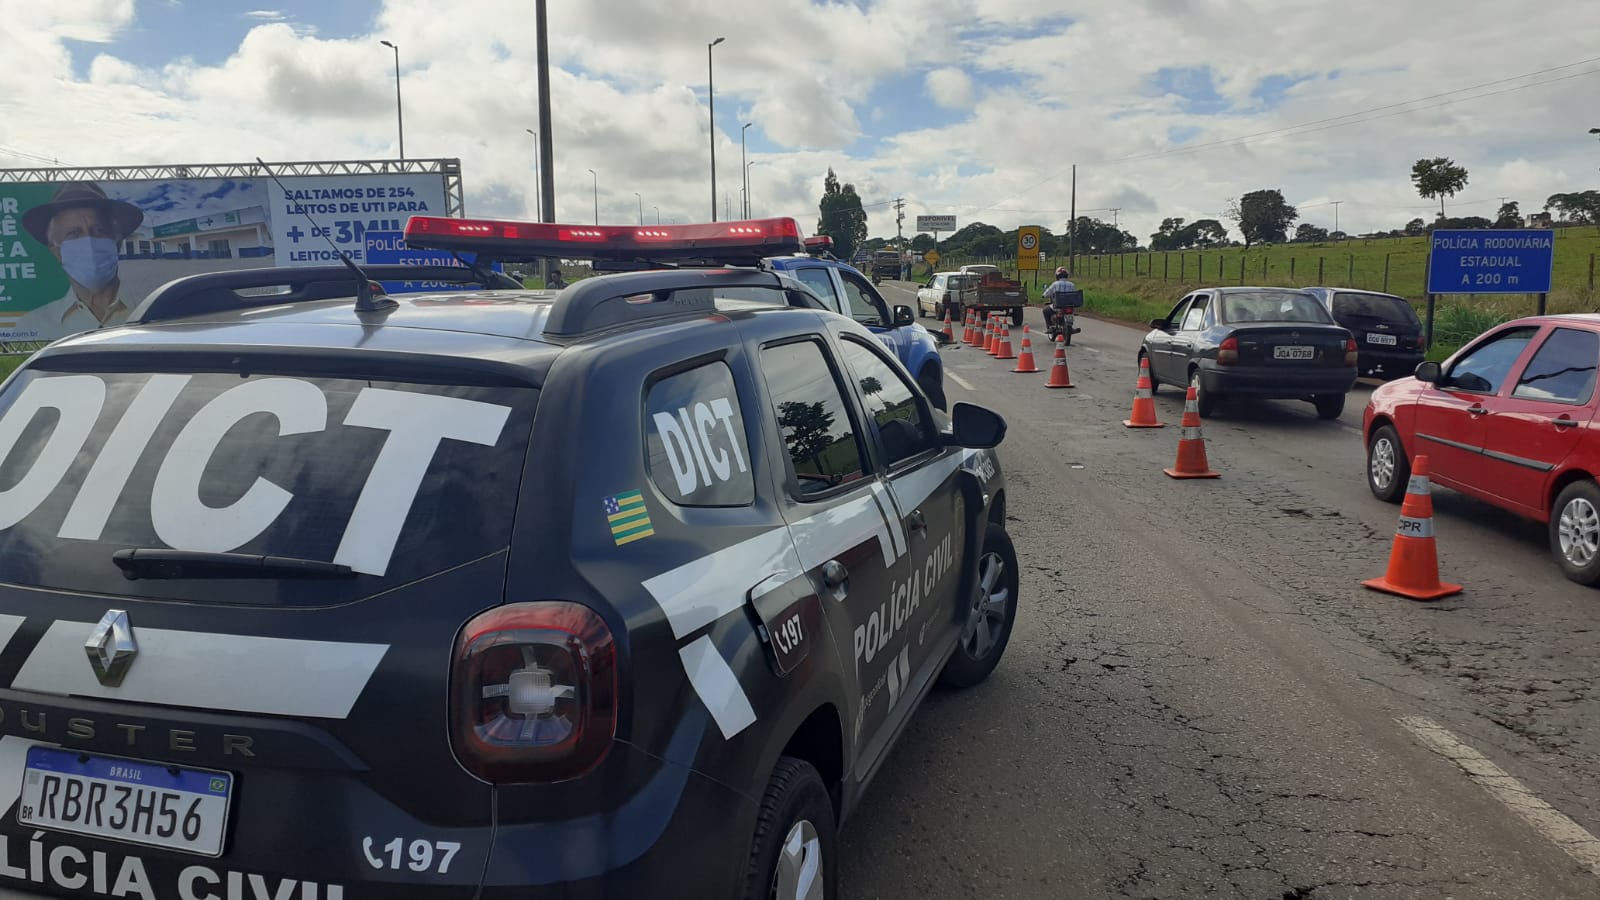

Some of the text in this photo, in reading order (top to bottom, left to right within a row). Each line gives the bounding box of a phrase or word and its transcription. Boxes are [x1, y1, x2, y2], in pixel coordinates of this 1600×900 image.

[285, 187, 415, 200] SALTAMOS DE 254
[0, 197, 18, 213] R
[286, 201, 428, 214] LEITOS DE UTI PARA
[0, 215, 17, 236] Ê
[311, 227, 331, 237] DE
[1433, 235, 1551, 249] POLÍCIA RODOVIÁRIA
[290, 250, 362, 262] LEITOS DE
[1460, 256, 1521, 267] ESTADUAL
[1461, 273, 1519, 285] A 200 m
[652, 397, 747, 497] DICT
[0, 374, 512, 577] DICT
[854, 568, 921, 680] POLÍCIA
[924, 530, 953, 597] CIVIL
[782, 613, 803, 650] 197
[0, 706, 256, 757] USTER
[109, 766, 142, 781] BRASIL
[21, 805, 33, 820] BR
[38, 775, 203, 842] RBR3H56
[384, 837, 461, 874] 197
